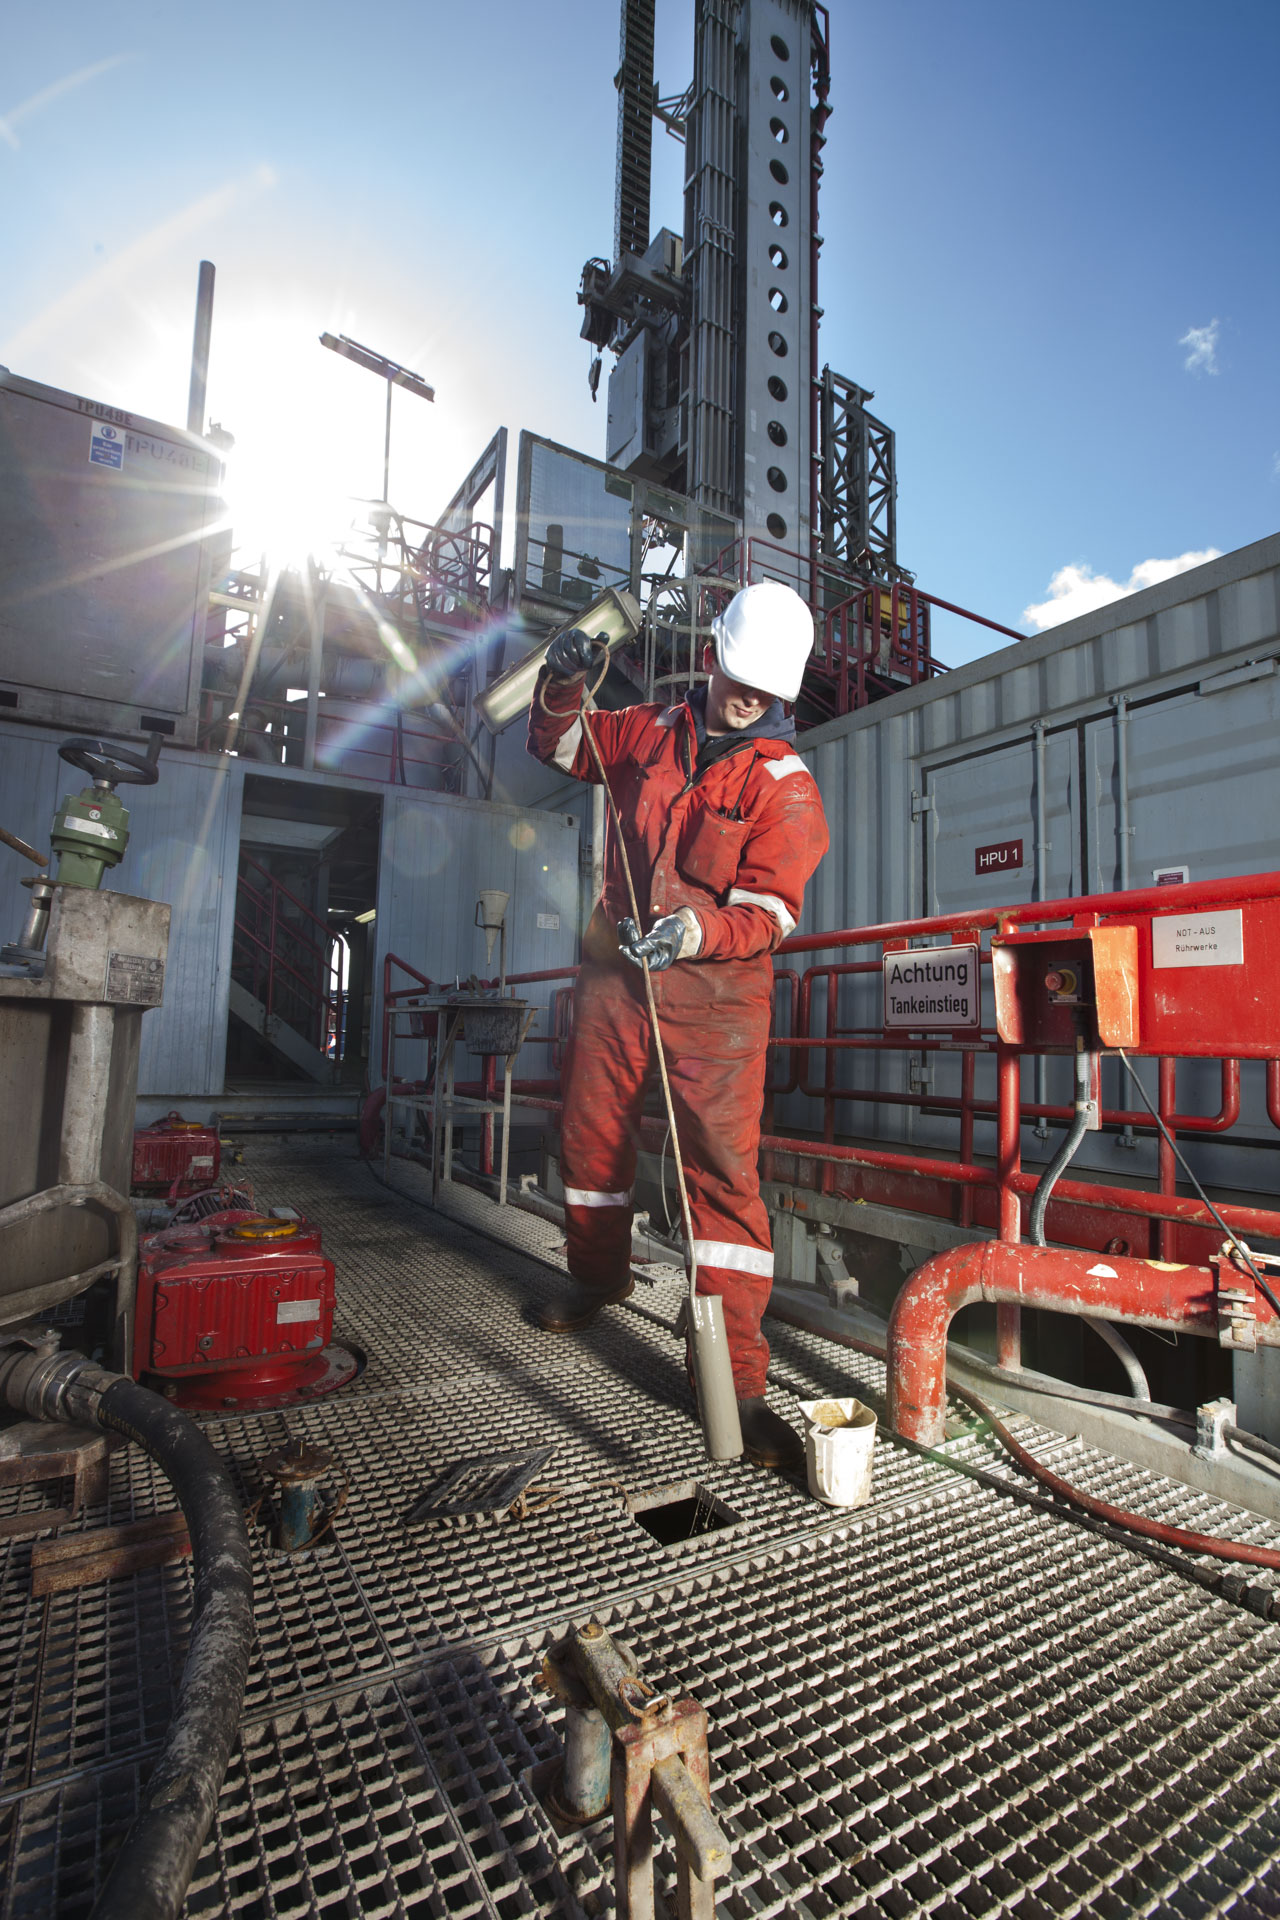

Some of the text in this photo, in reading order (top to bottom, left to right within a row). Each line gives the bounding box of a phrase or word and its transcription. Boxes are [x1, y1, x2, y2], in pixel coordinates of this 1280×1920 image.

[76, 398, 133, 426] TPU48E
[980, 848, 1018, 867] HPU 1
[1175, 942, 1218, 953] Rührwerke
[890, 962, 968, 986] Achtung
[890, 994, 968, 1018] Tankeinstieg
